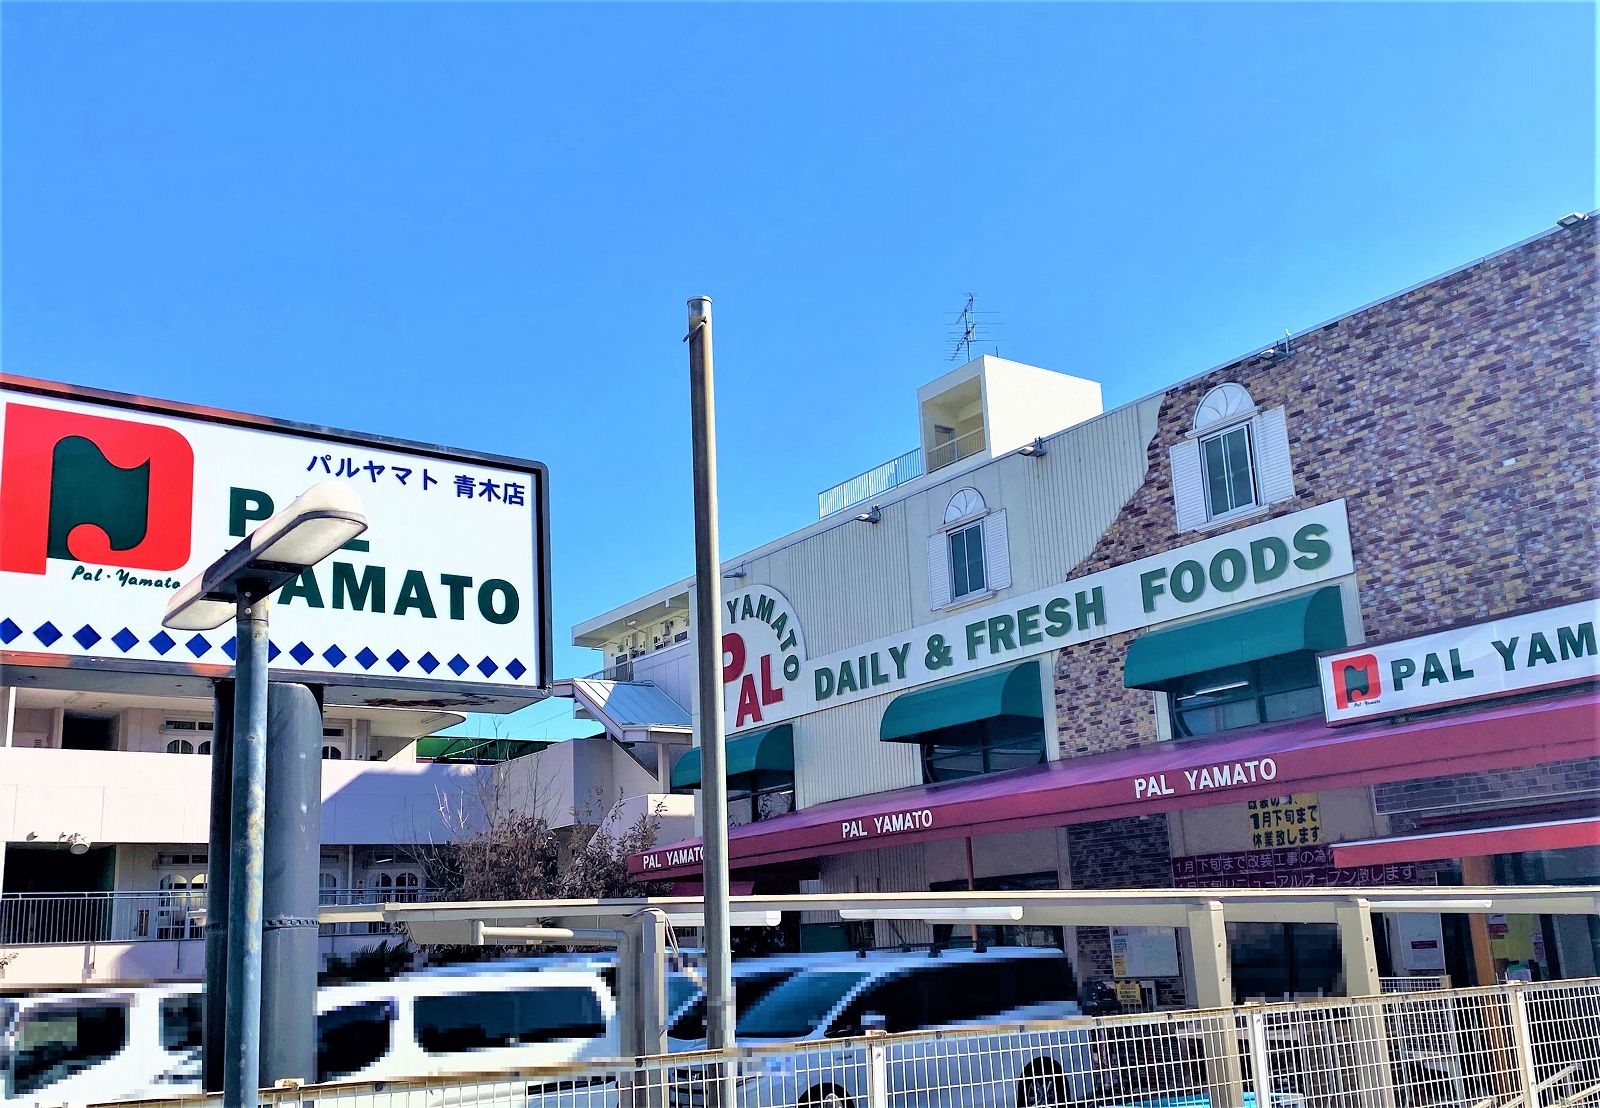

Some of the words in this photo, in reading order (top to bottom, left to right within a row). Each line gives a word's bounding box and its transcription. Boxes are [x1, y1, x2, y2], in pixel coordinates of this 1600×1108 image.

[306, 454, 438, 491] パルヤマト
[453, 474, 526, 507] 青木店
[224, 549, 520, 625] AMATO
[814, 642, 911, 702] DAILY
[924, 633, 953, 671] &
[965, 585, 1107, 661] FRESH
[1140, 523, 1333, 614] FOODS
[726, 594, 800, 681] YAMATO
[1390, 648, 1475, 692] PAL
[1134, 774, 1175, 799] PAL
[1184, 758, 1277, 791] YAMATO
[842, 821, 868, 838] PAL
[874, 809, 933, 833] YAMATO
[1250, 804, 1319, 830] 1月下旬まで
[1252, 826, 1320, 848] 休業致します
[643, 854, 662, 869] PAL
